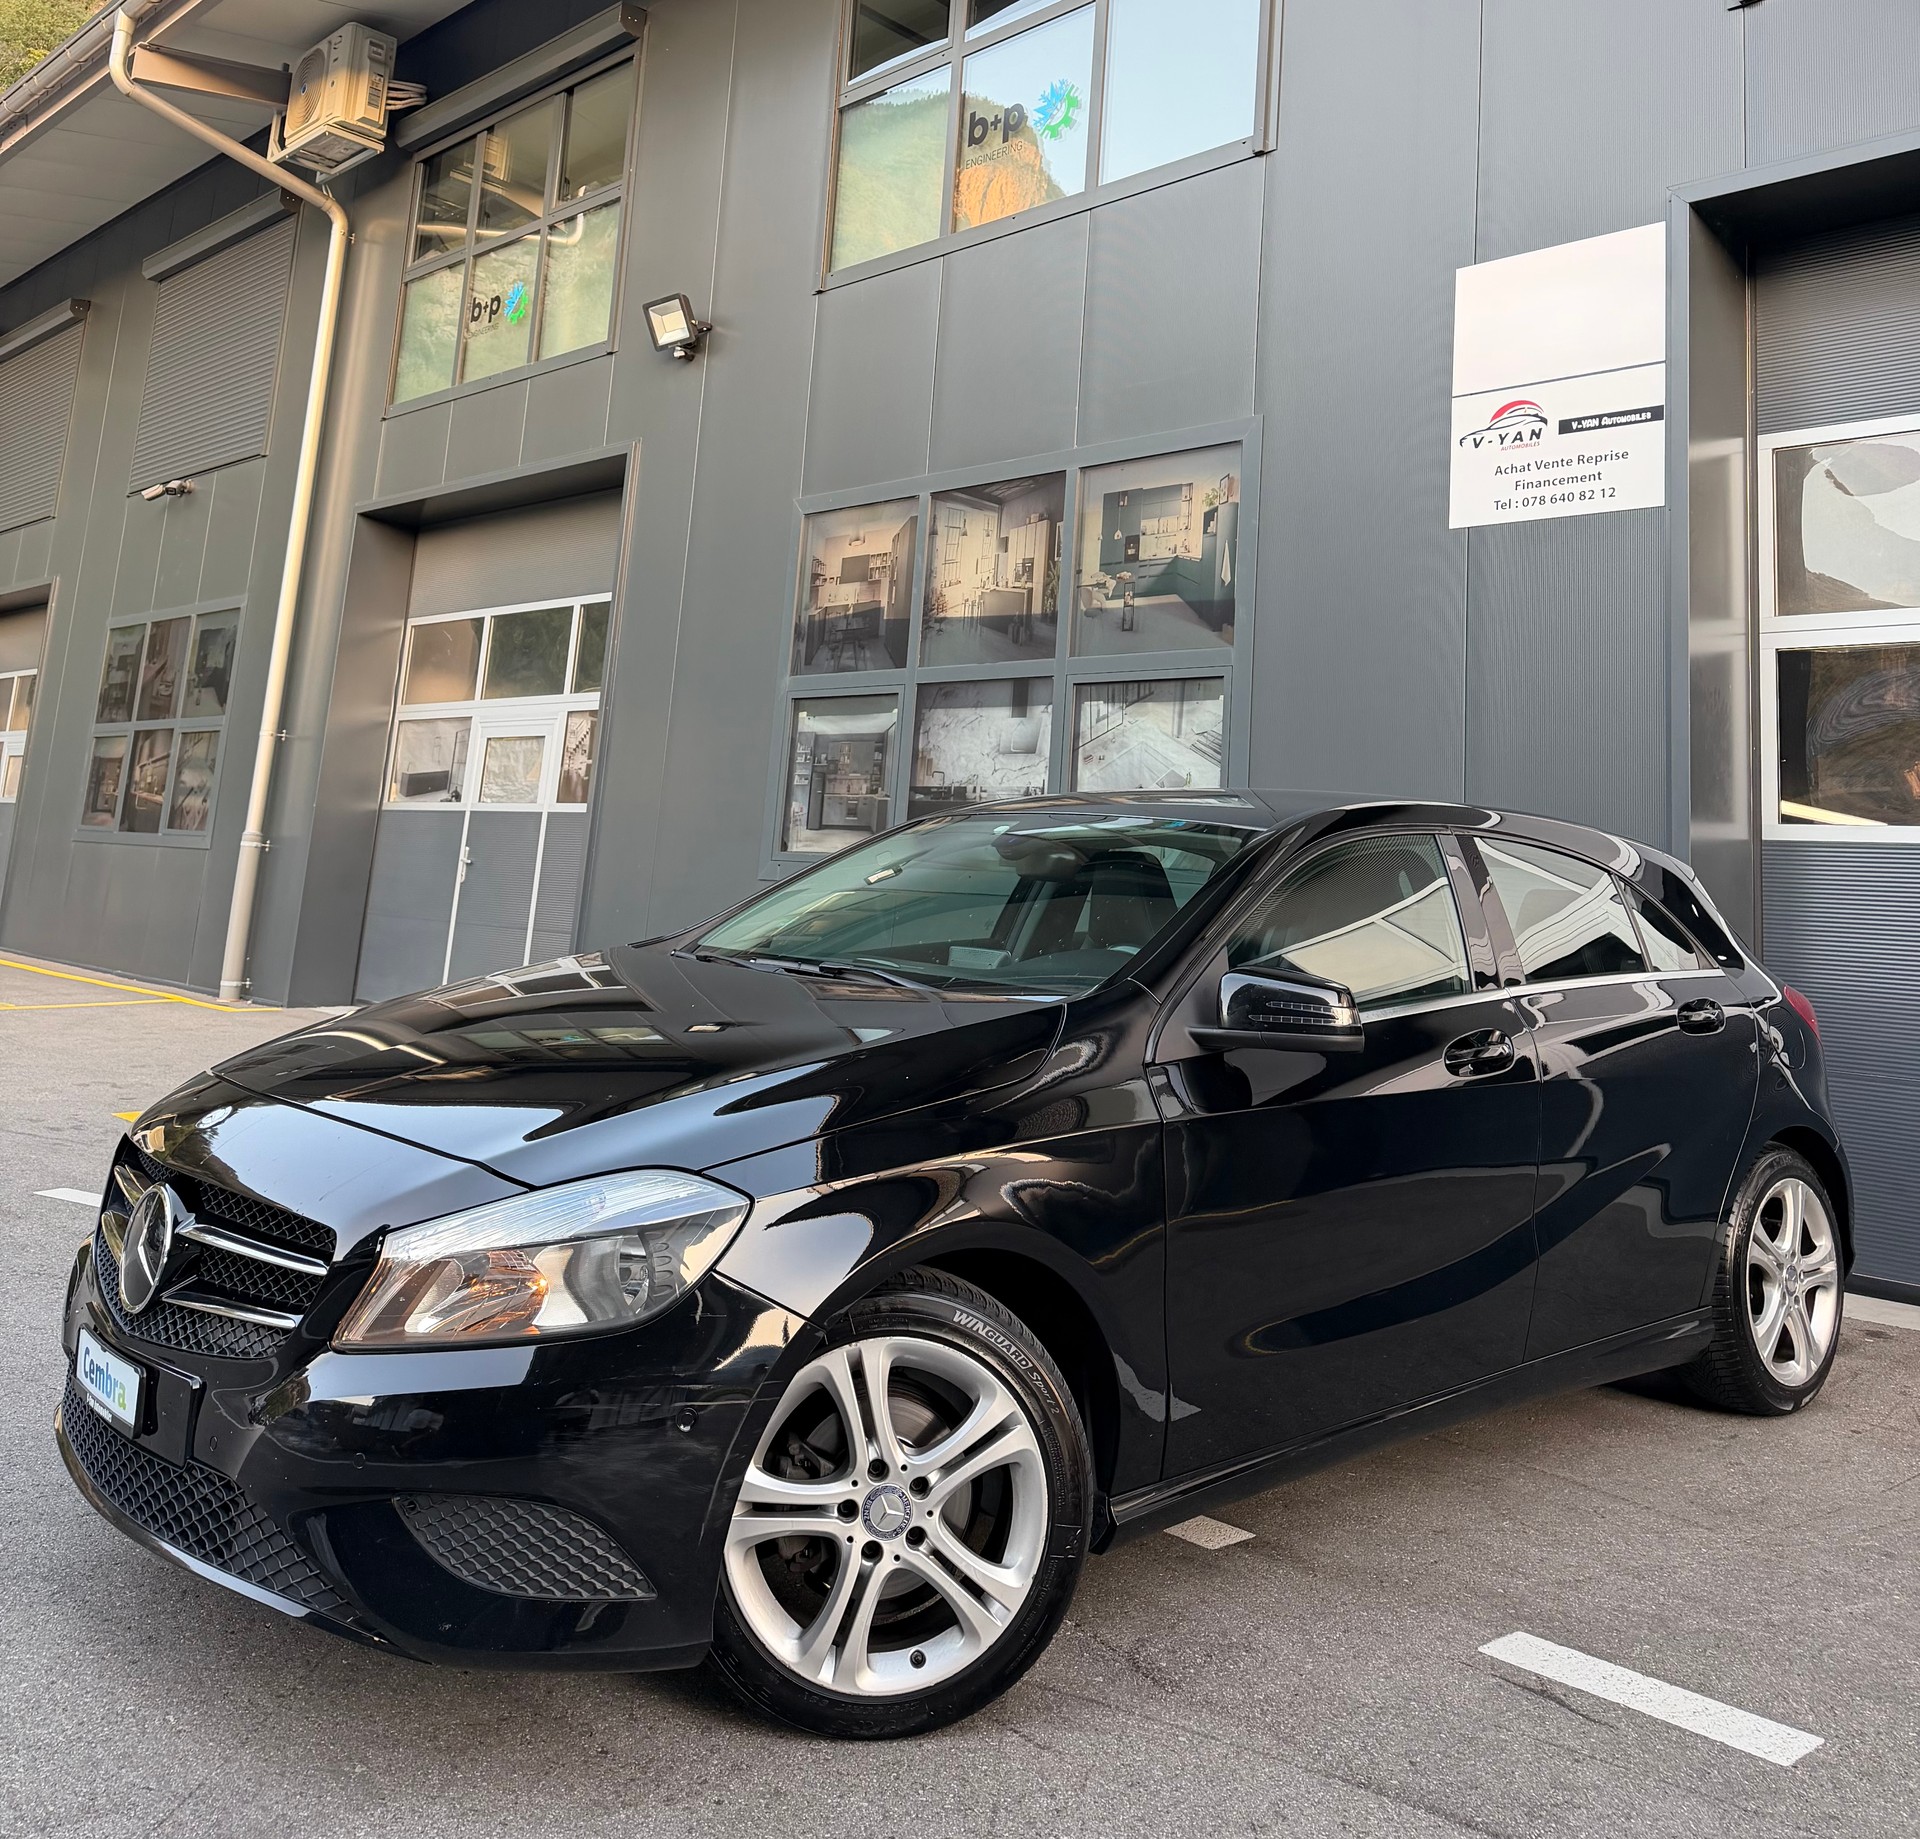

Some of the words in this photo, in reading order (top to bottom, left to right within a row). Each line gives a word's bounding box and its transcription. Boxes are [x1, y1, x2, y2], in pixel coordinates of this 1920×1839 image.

[967, 103, 1025, 147] b+p
[965, 140, 1023, 169] ENGINEERING
[470, 295, 501, 323] b+p
[1472, 427, 1542, 449] V-YAN
[1571, 419, 1599, 431] V-YAN
[1500, 440, 1540, 452] AUTOMOBILES
[1494, 462, 1531, 476] Achat
[1535, 457, 1573, 471] Vente
[1577, 450, 1629, 466] Reprise
[1514, 471, 1603, 491] Financement
[1522, 495, 1546, 508] 078
[1550, 491, 1575, 505] 640
[1579, 488, 1595, 501] 82
[1600, 486, 1616, 499] 12
[953, 1310, 1033, 1370] WINGUARD
[83, 1346, 126, 1411] Cembra
[1027, 1371, 1055, 1406] Sport
